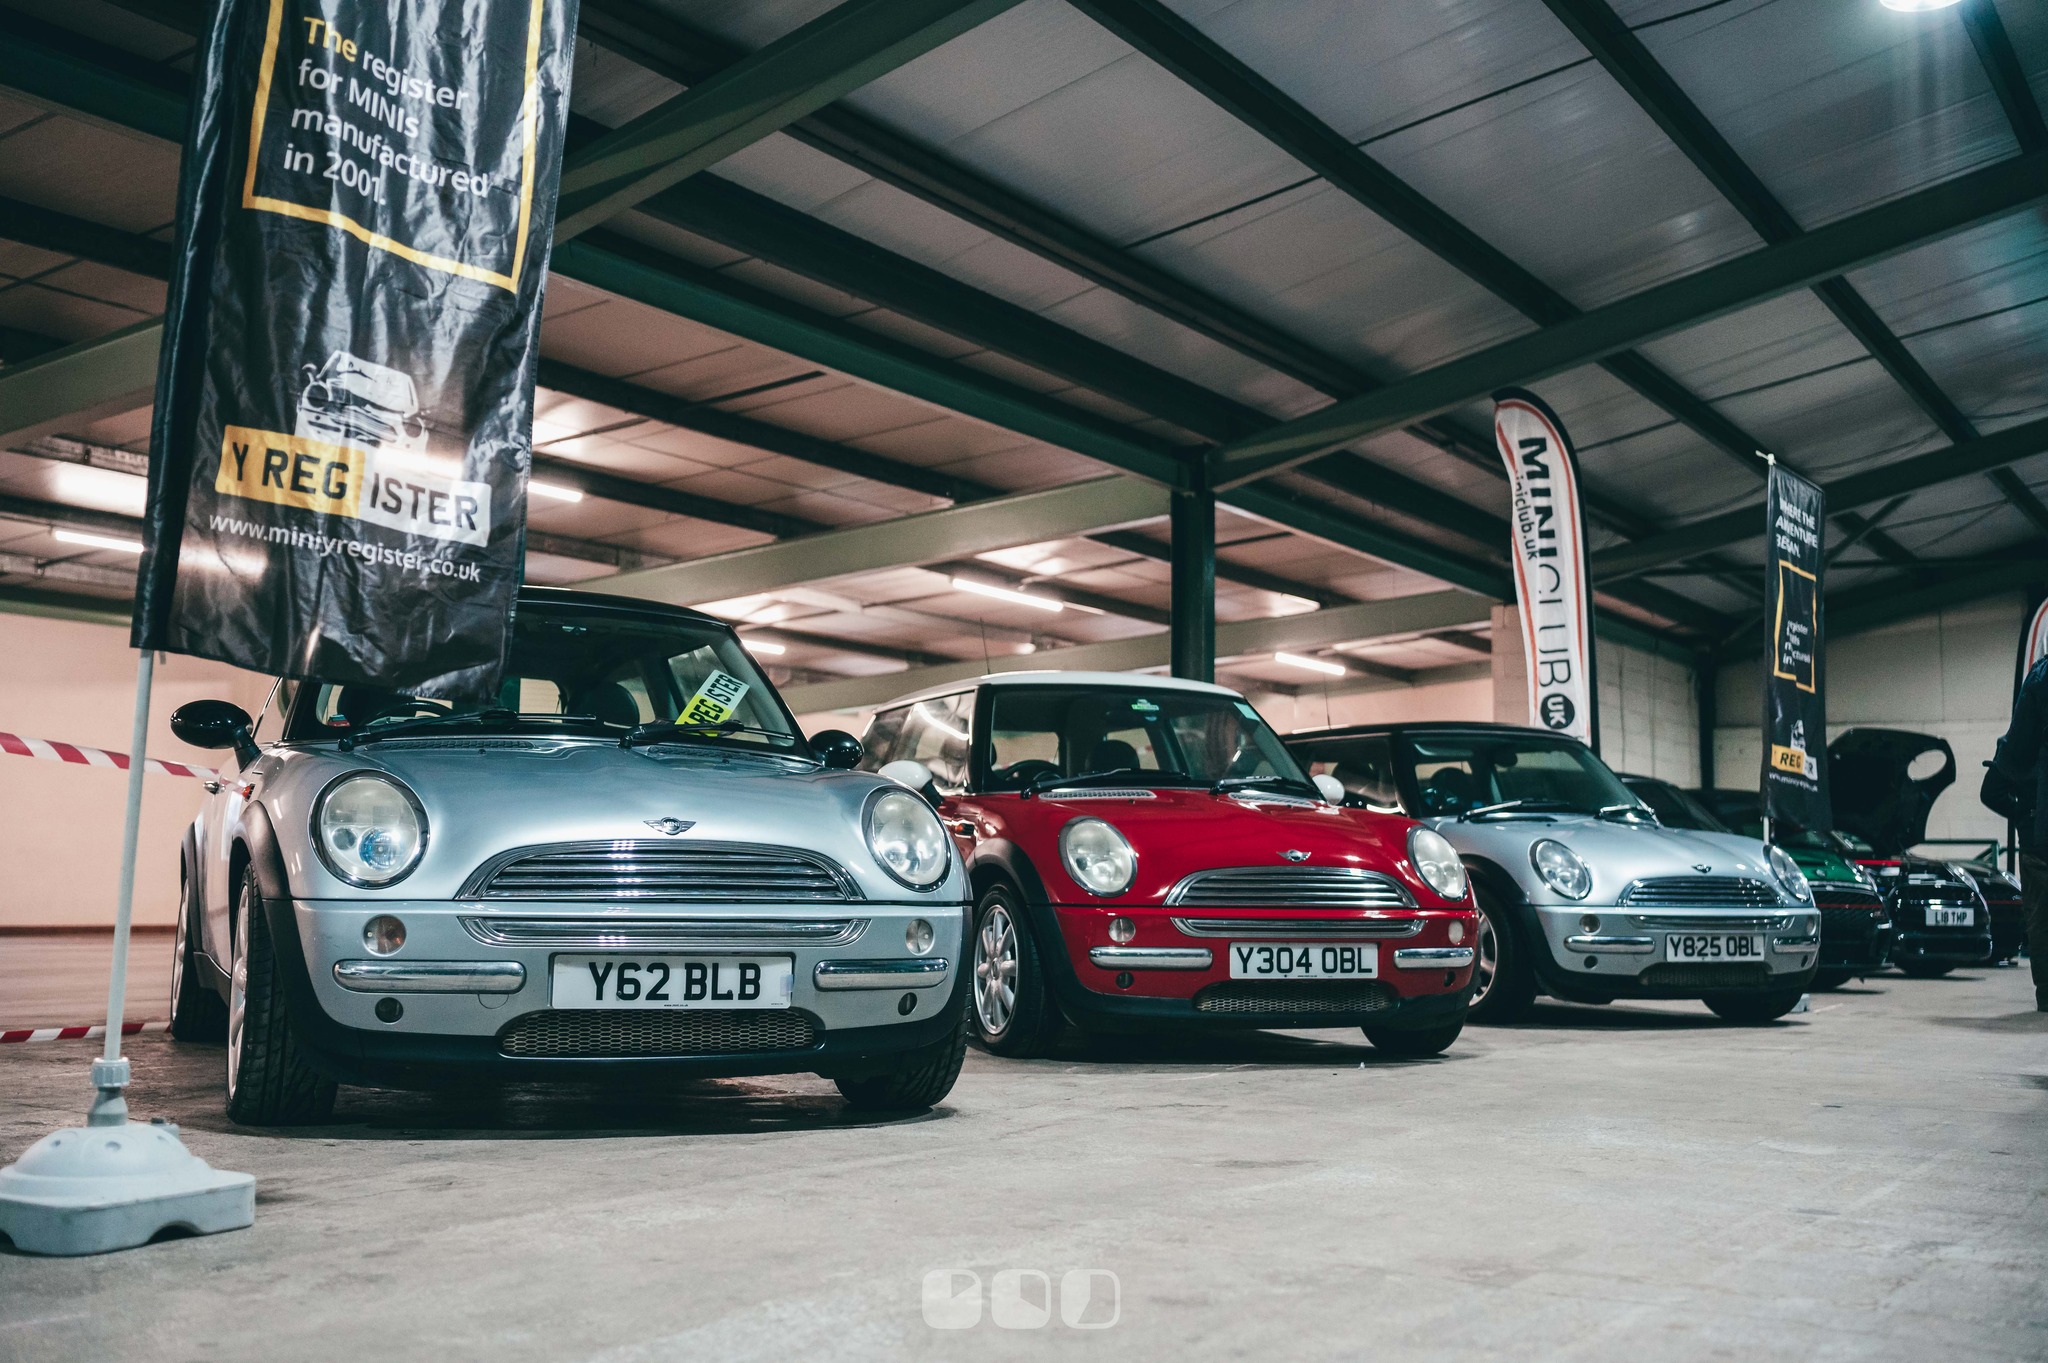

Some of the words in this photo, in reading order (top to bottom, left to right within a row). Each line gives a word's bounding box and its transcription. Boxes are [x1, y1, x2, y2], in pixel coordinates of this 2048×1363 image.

[303, 16, 358, 62] The
[362, 50, 469, 110] register
[298, 58, 343, 94] for
[348, 77, 419, 138] MINIs
[283, 142, 314, 174] in
[322, 151, 386, 206] 2001.
[291, 108, 489, 198] manufactured
[232, 441, 250, 482] Y
[261, 447, 349, 500] REG
[369, 472, 479, 531] ISTER
[209, 514, 481, 583] www.miniyregister.co.uk
[704, 674, 743, 705] ISTER
[1547, 696, 1566, 726] UK
[1236, 947, 1312, 973] Y304
[1321, 947, 1372, 973] OBL
[1669, 936, 1721, 957] Y825
[1726, 936, 1761, 957] OBL
[588, 962, 670, 1000] Y62
[684, 962, 761, 1000] BLB
